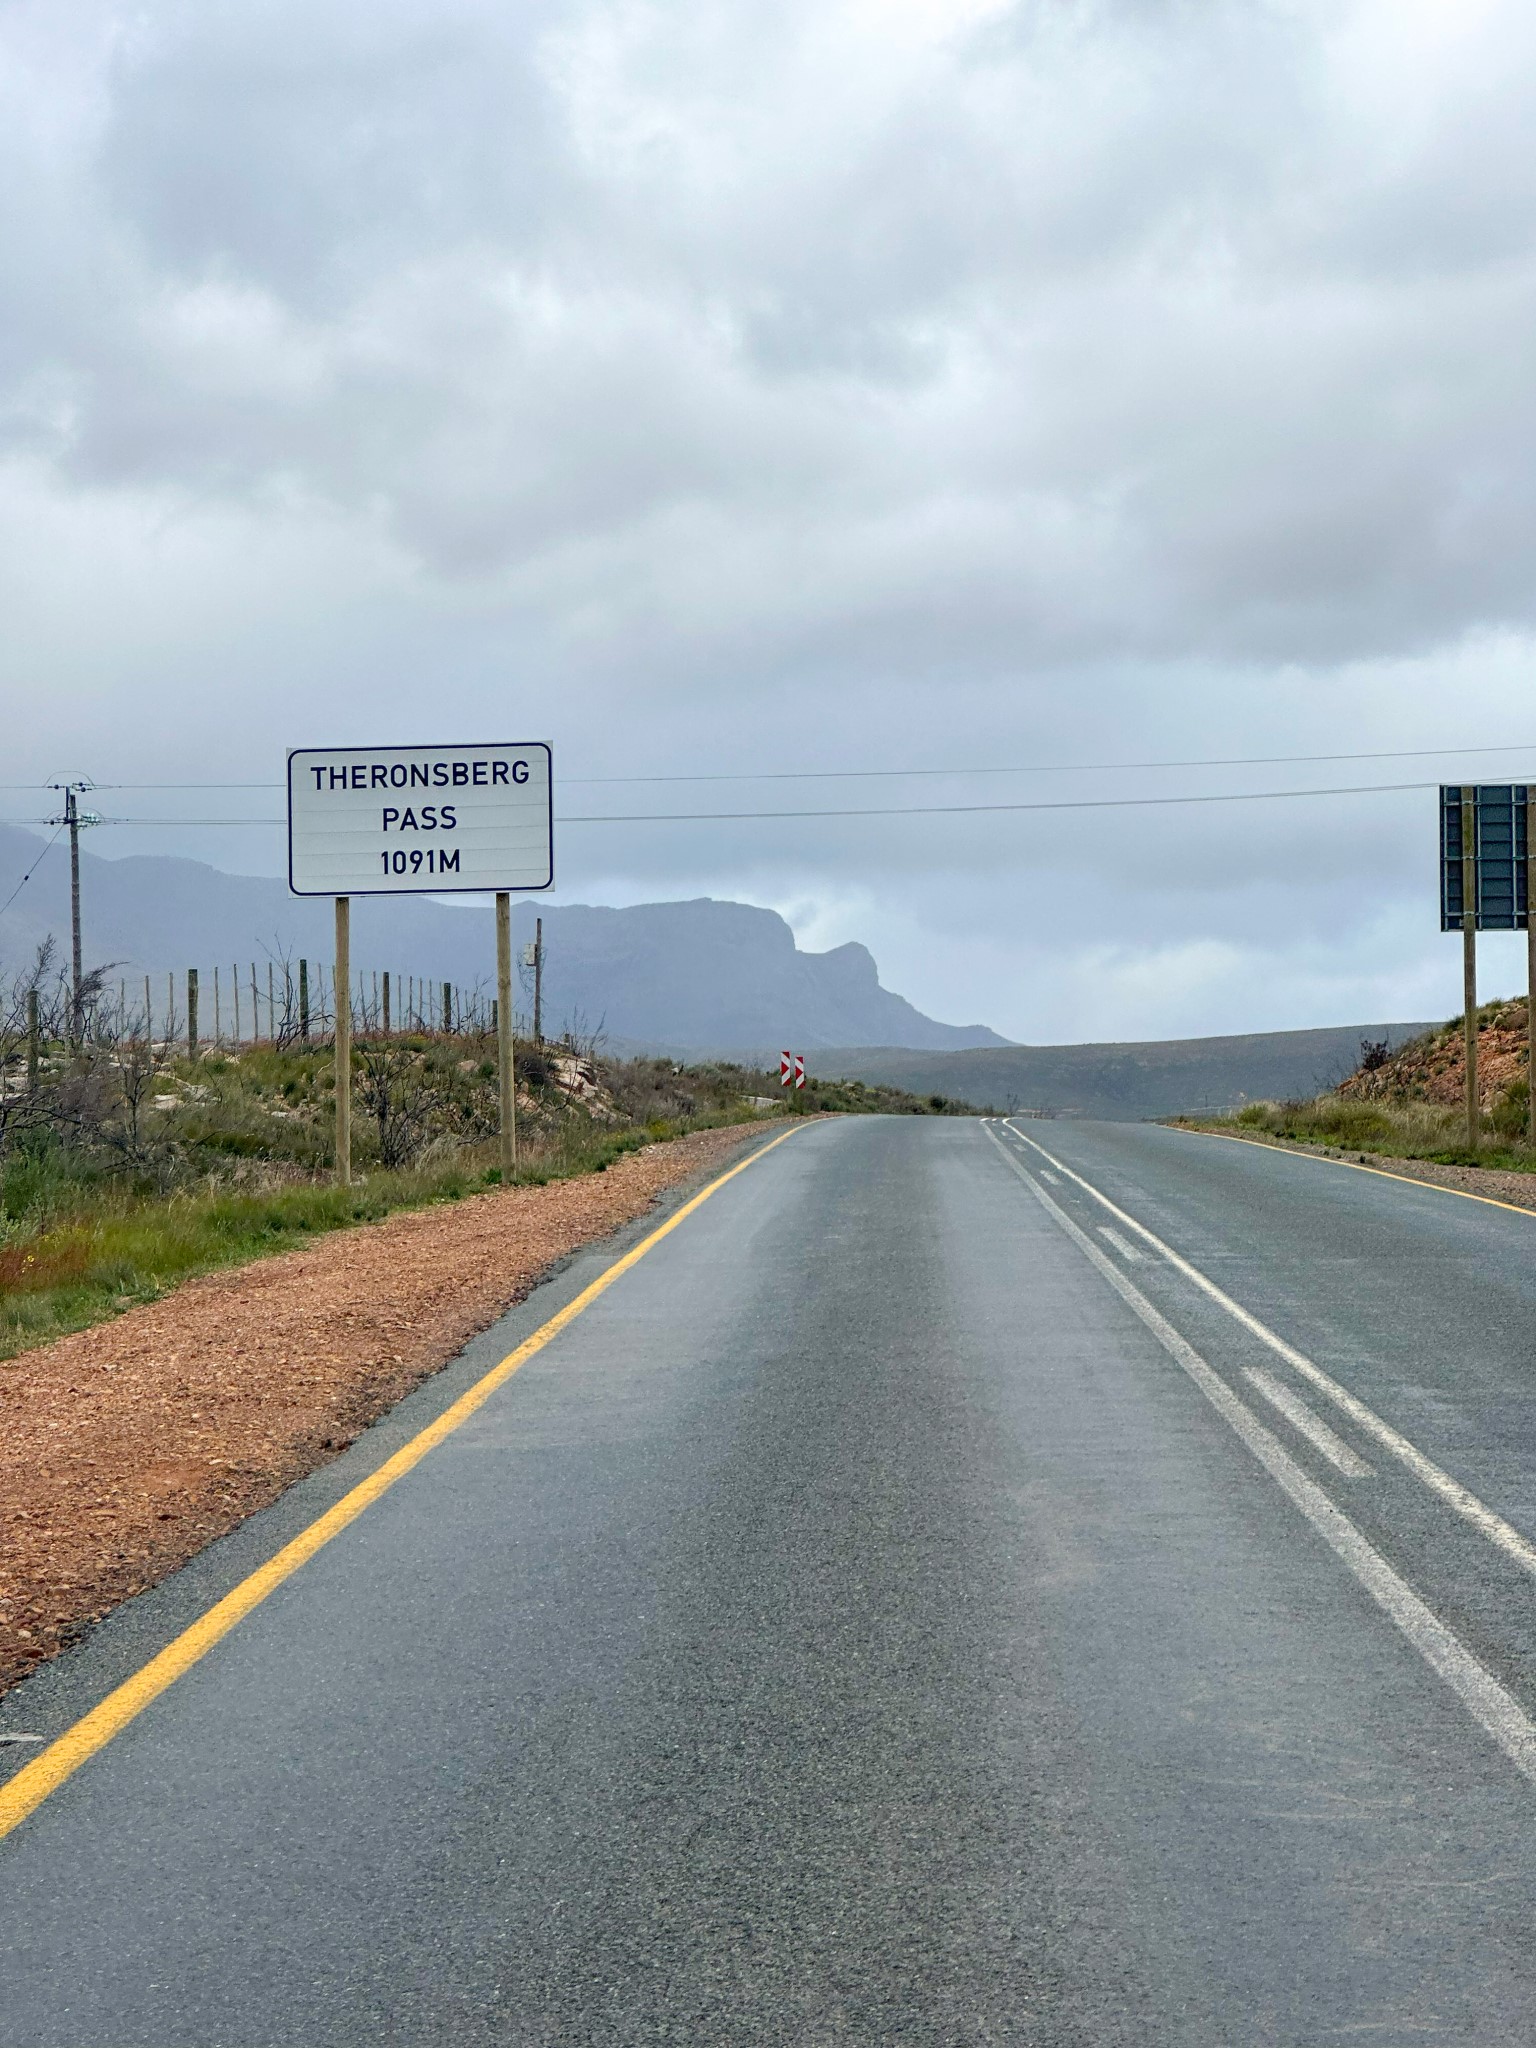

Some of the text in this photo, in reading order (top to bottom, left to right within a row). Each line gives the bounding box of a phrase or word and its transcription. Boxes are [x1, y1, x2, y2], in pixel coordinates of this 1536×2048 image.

[310, 760, 530, 790] THERONSBERG
[382, 805, 457, 831] PASS
[380, 848, 460, 875] 1091M
